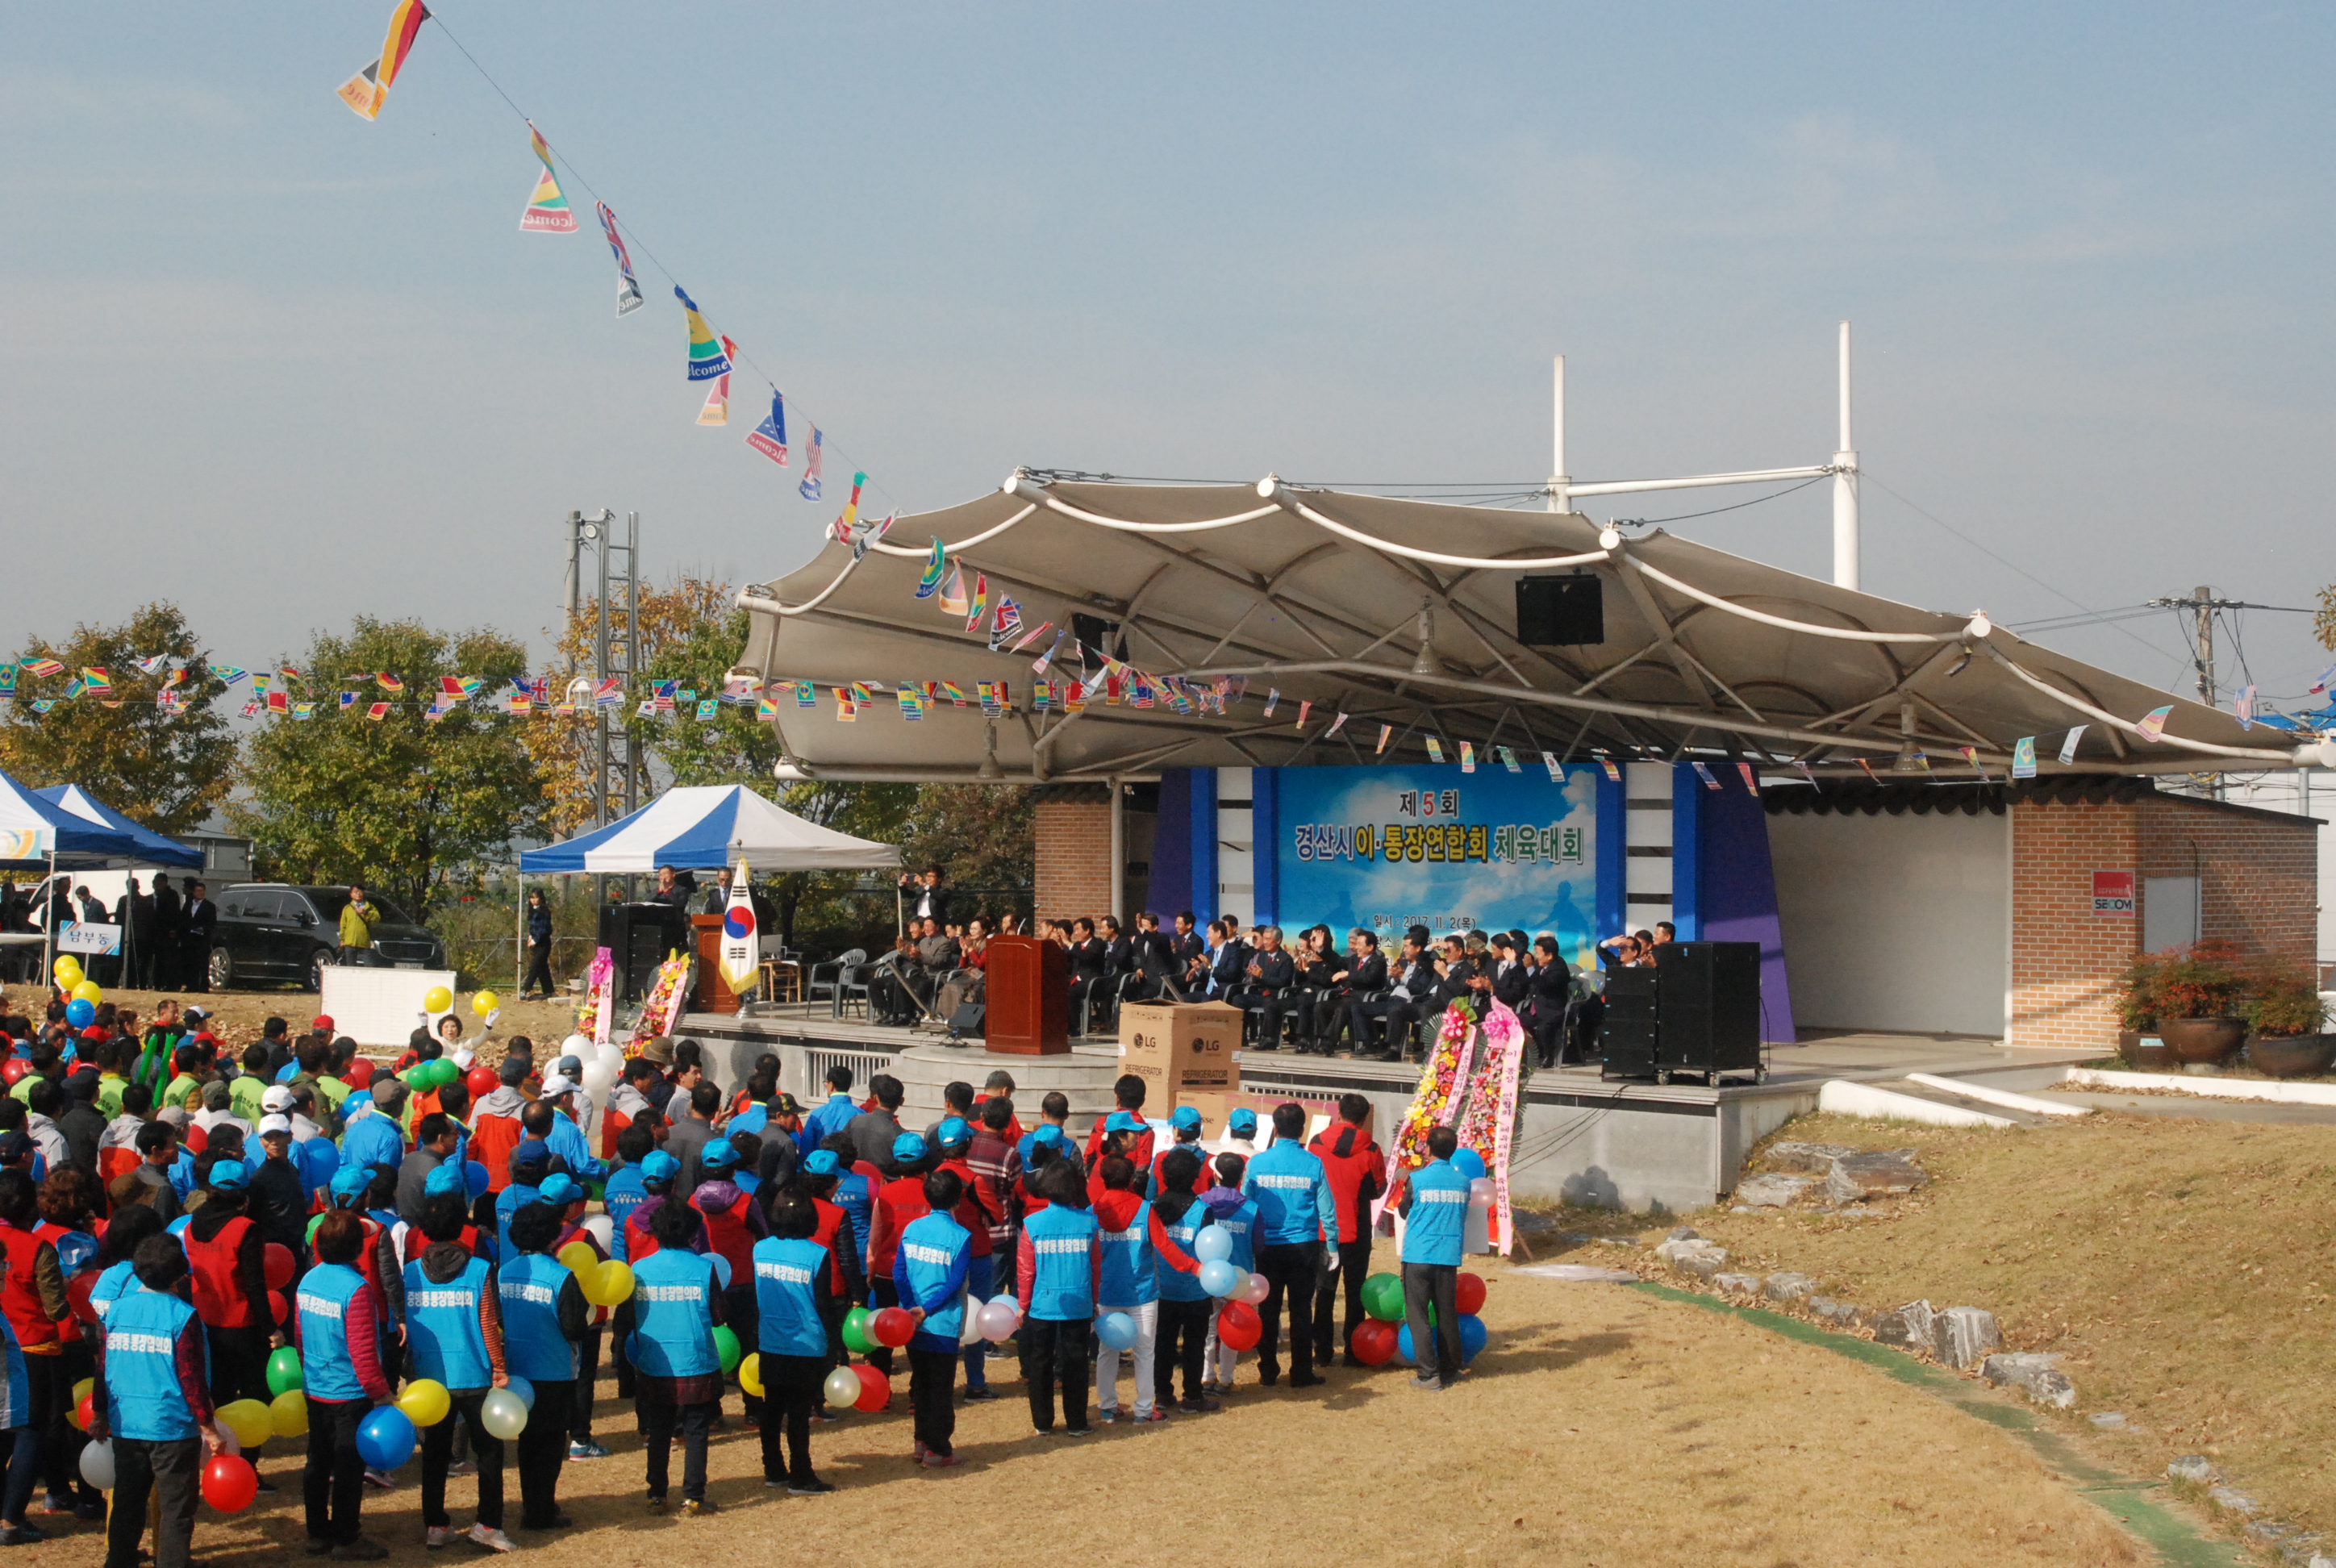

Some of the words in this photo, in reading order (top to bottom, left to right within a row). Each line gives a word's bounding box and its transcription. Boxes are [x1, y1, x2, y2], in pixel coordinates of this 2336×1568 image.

[1495, 825, 1584, 864] 체육대회
[2095, 899, 2132, 910] SECOM
[71, 932, 109, 945] 남부동
[1145, 1036, 1157, 1048] LG
[1205, 1040, 1220, 1051] LG
[1124, 1064, 1162, 1077] REFRIGERATOR
[1182, 1070, 1228, 1079] REFRIGERATOR
[130, 1334, 173, 1356] 통장협의회
